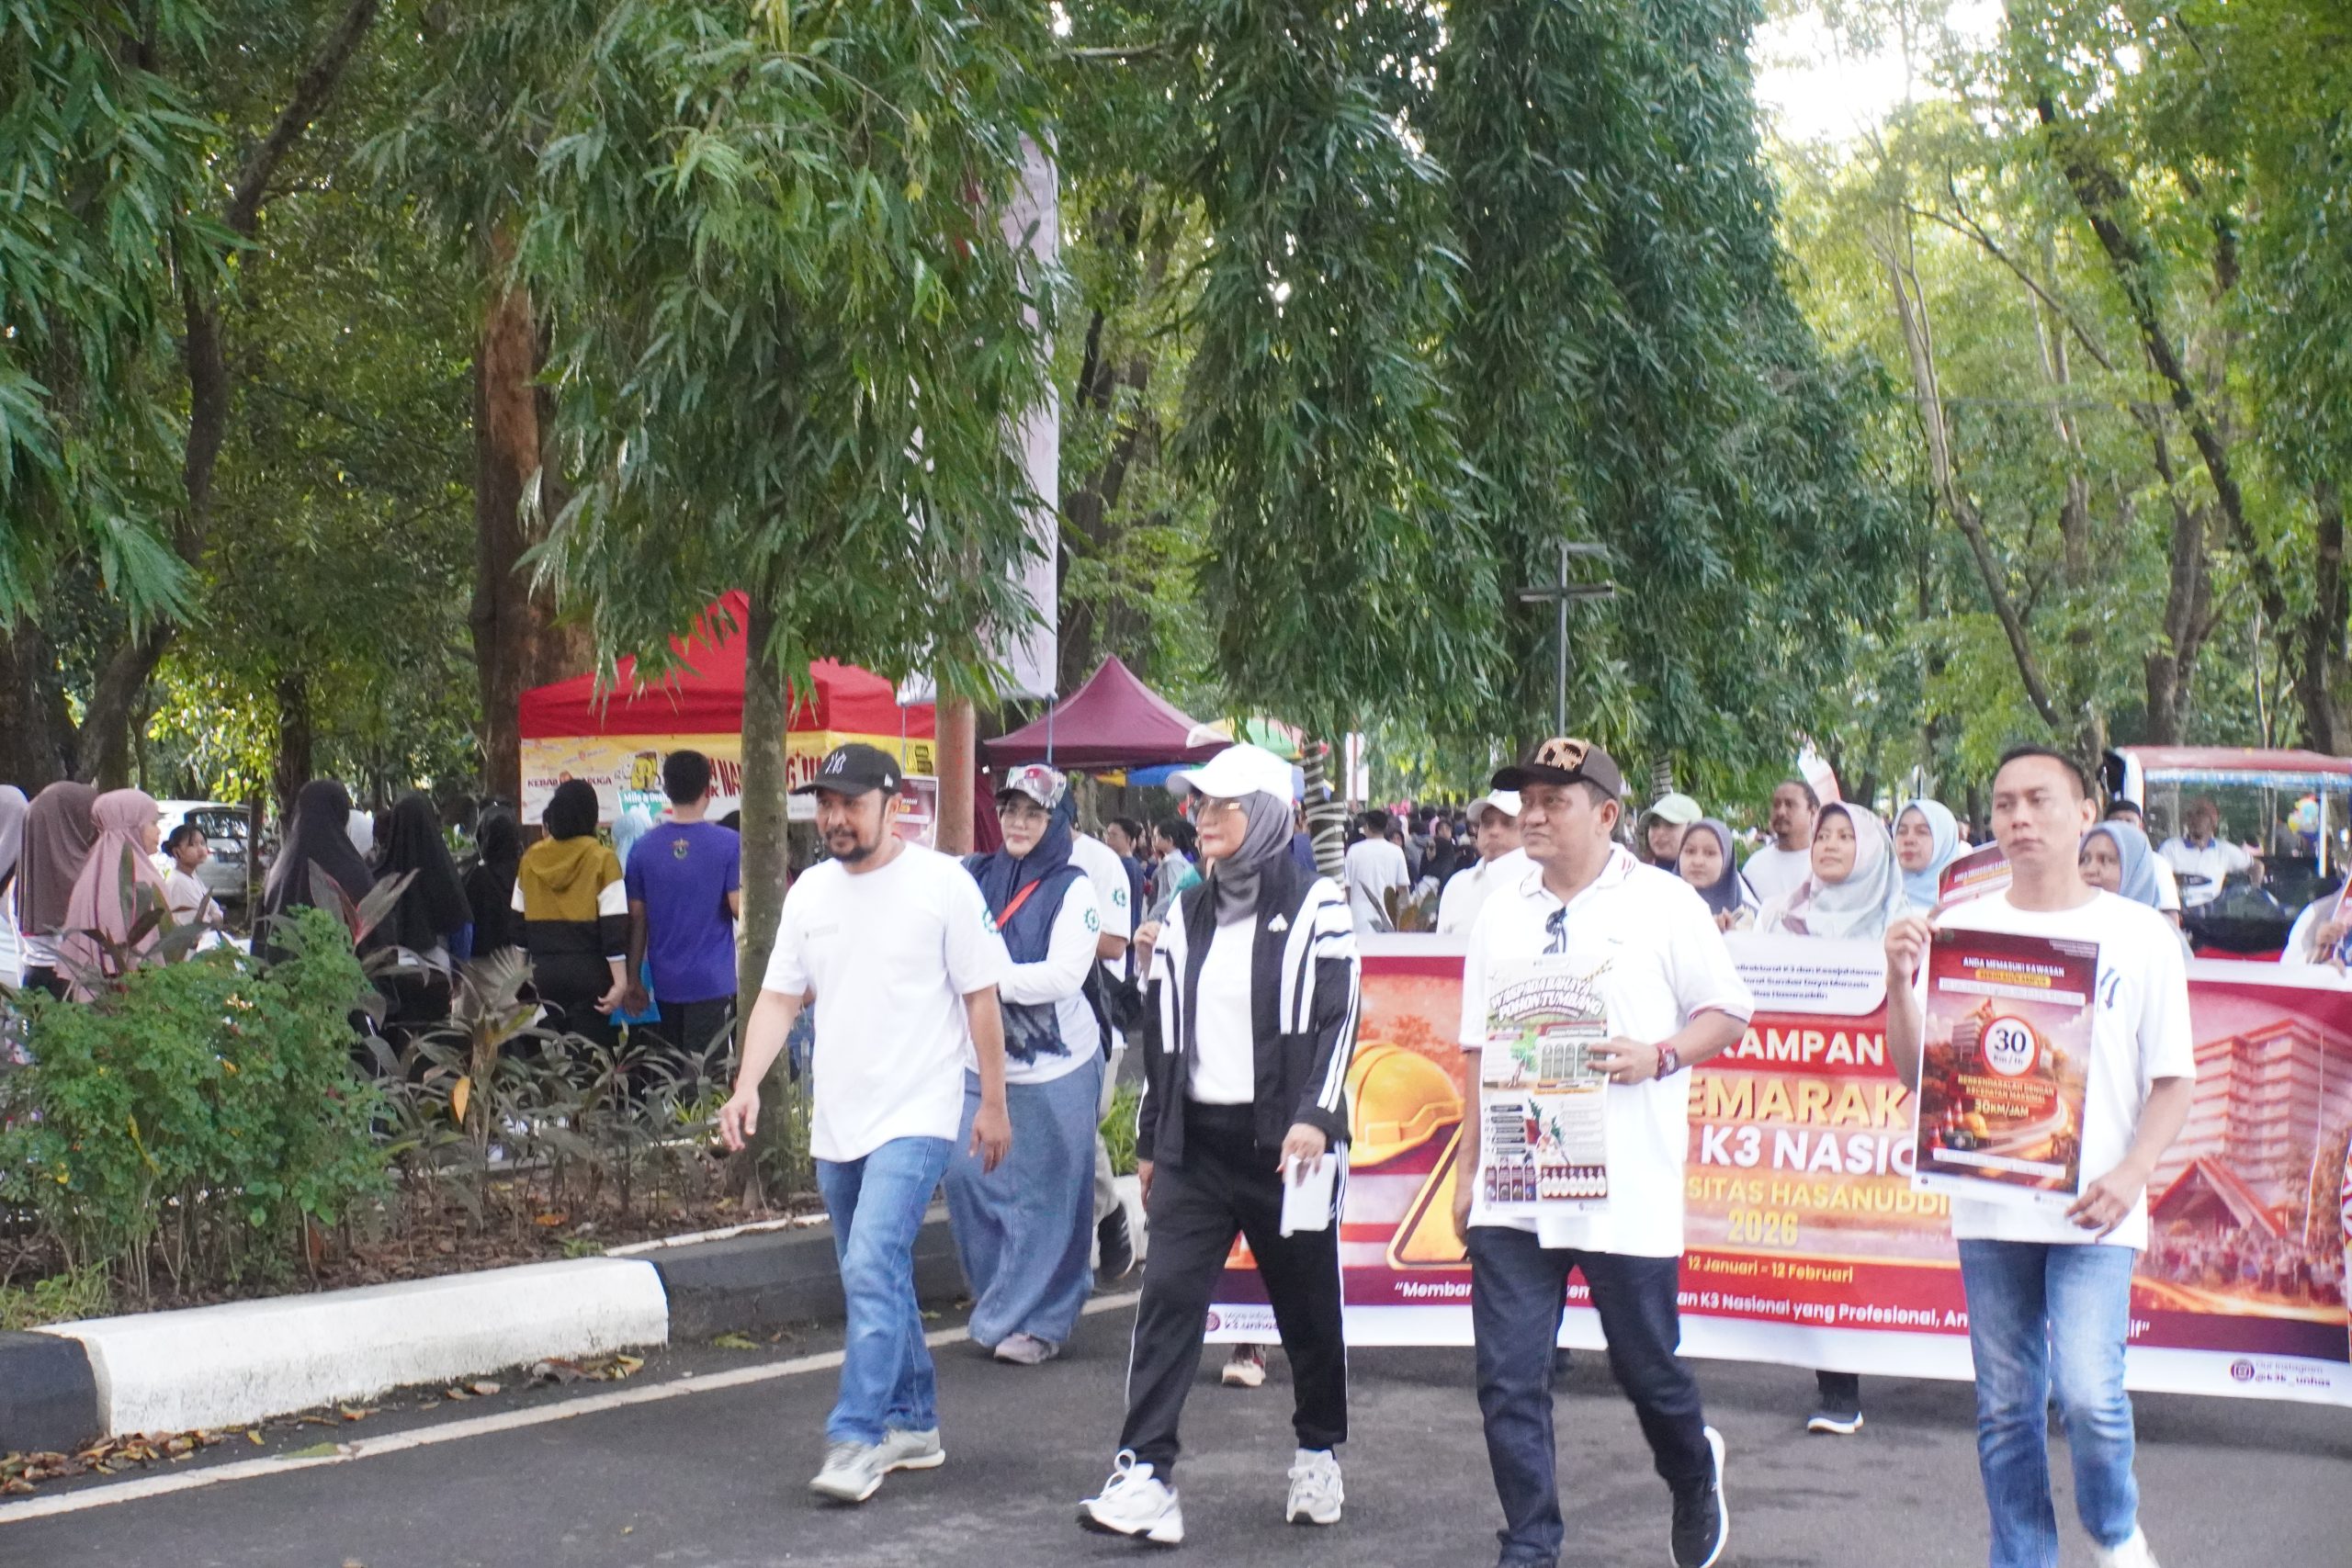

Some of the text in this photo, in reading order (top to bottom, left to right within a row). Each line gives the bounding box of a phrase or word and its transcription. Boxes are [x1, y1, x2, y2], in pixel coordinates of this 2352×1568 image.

[527, 778, 559, 788] KEBAB
[1962, 956, 1984, 968] ANDA
[1985, 958, 2025, 973] MEMASUKI
[2026, 963, 2064, 978] KAWASAN
[1723, 1027, 1883, 1066] AMPAN
[1994, 1028, 2027, 1054] 30
[1687, 1076, 1909, 1130] EMARAK
[1701, 1123, 1761, 1168] K3
[1773, 1129, 1914, 1178] NASIO
[1771, 1181, 1951, 1215] HASANUDDI
[1728, 1209, 1799, 1247] 2026
[1687, 1255, 1700, 1271] 12
[1703, 1258, 1758, 1276] Januari
[1771, 1262, 1785, 1279] 12
[1788, 1263, 1854, 1284] Februari
[1701, 1292, 1719, 1309] K3
[1723, 1293, 1790, 1315] Nasional
[1792, 1301, 1835, 1324] yang
[1839, 1304, 1940, 1327] Profesional,
